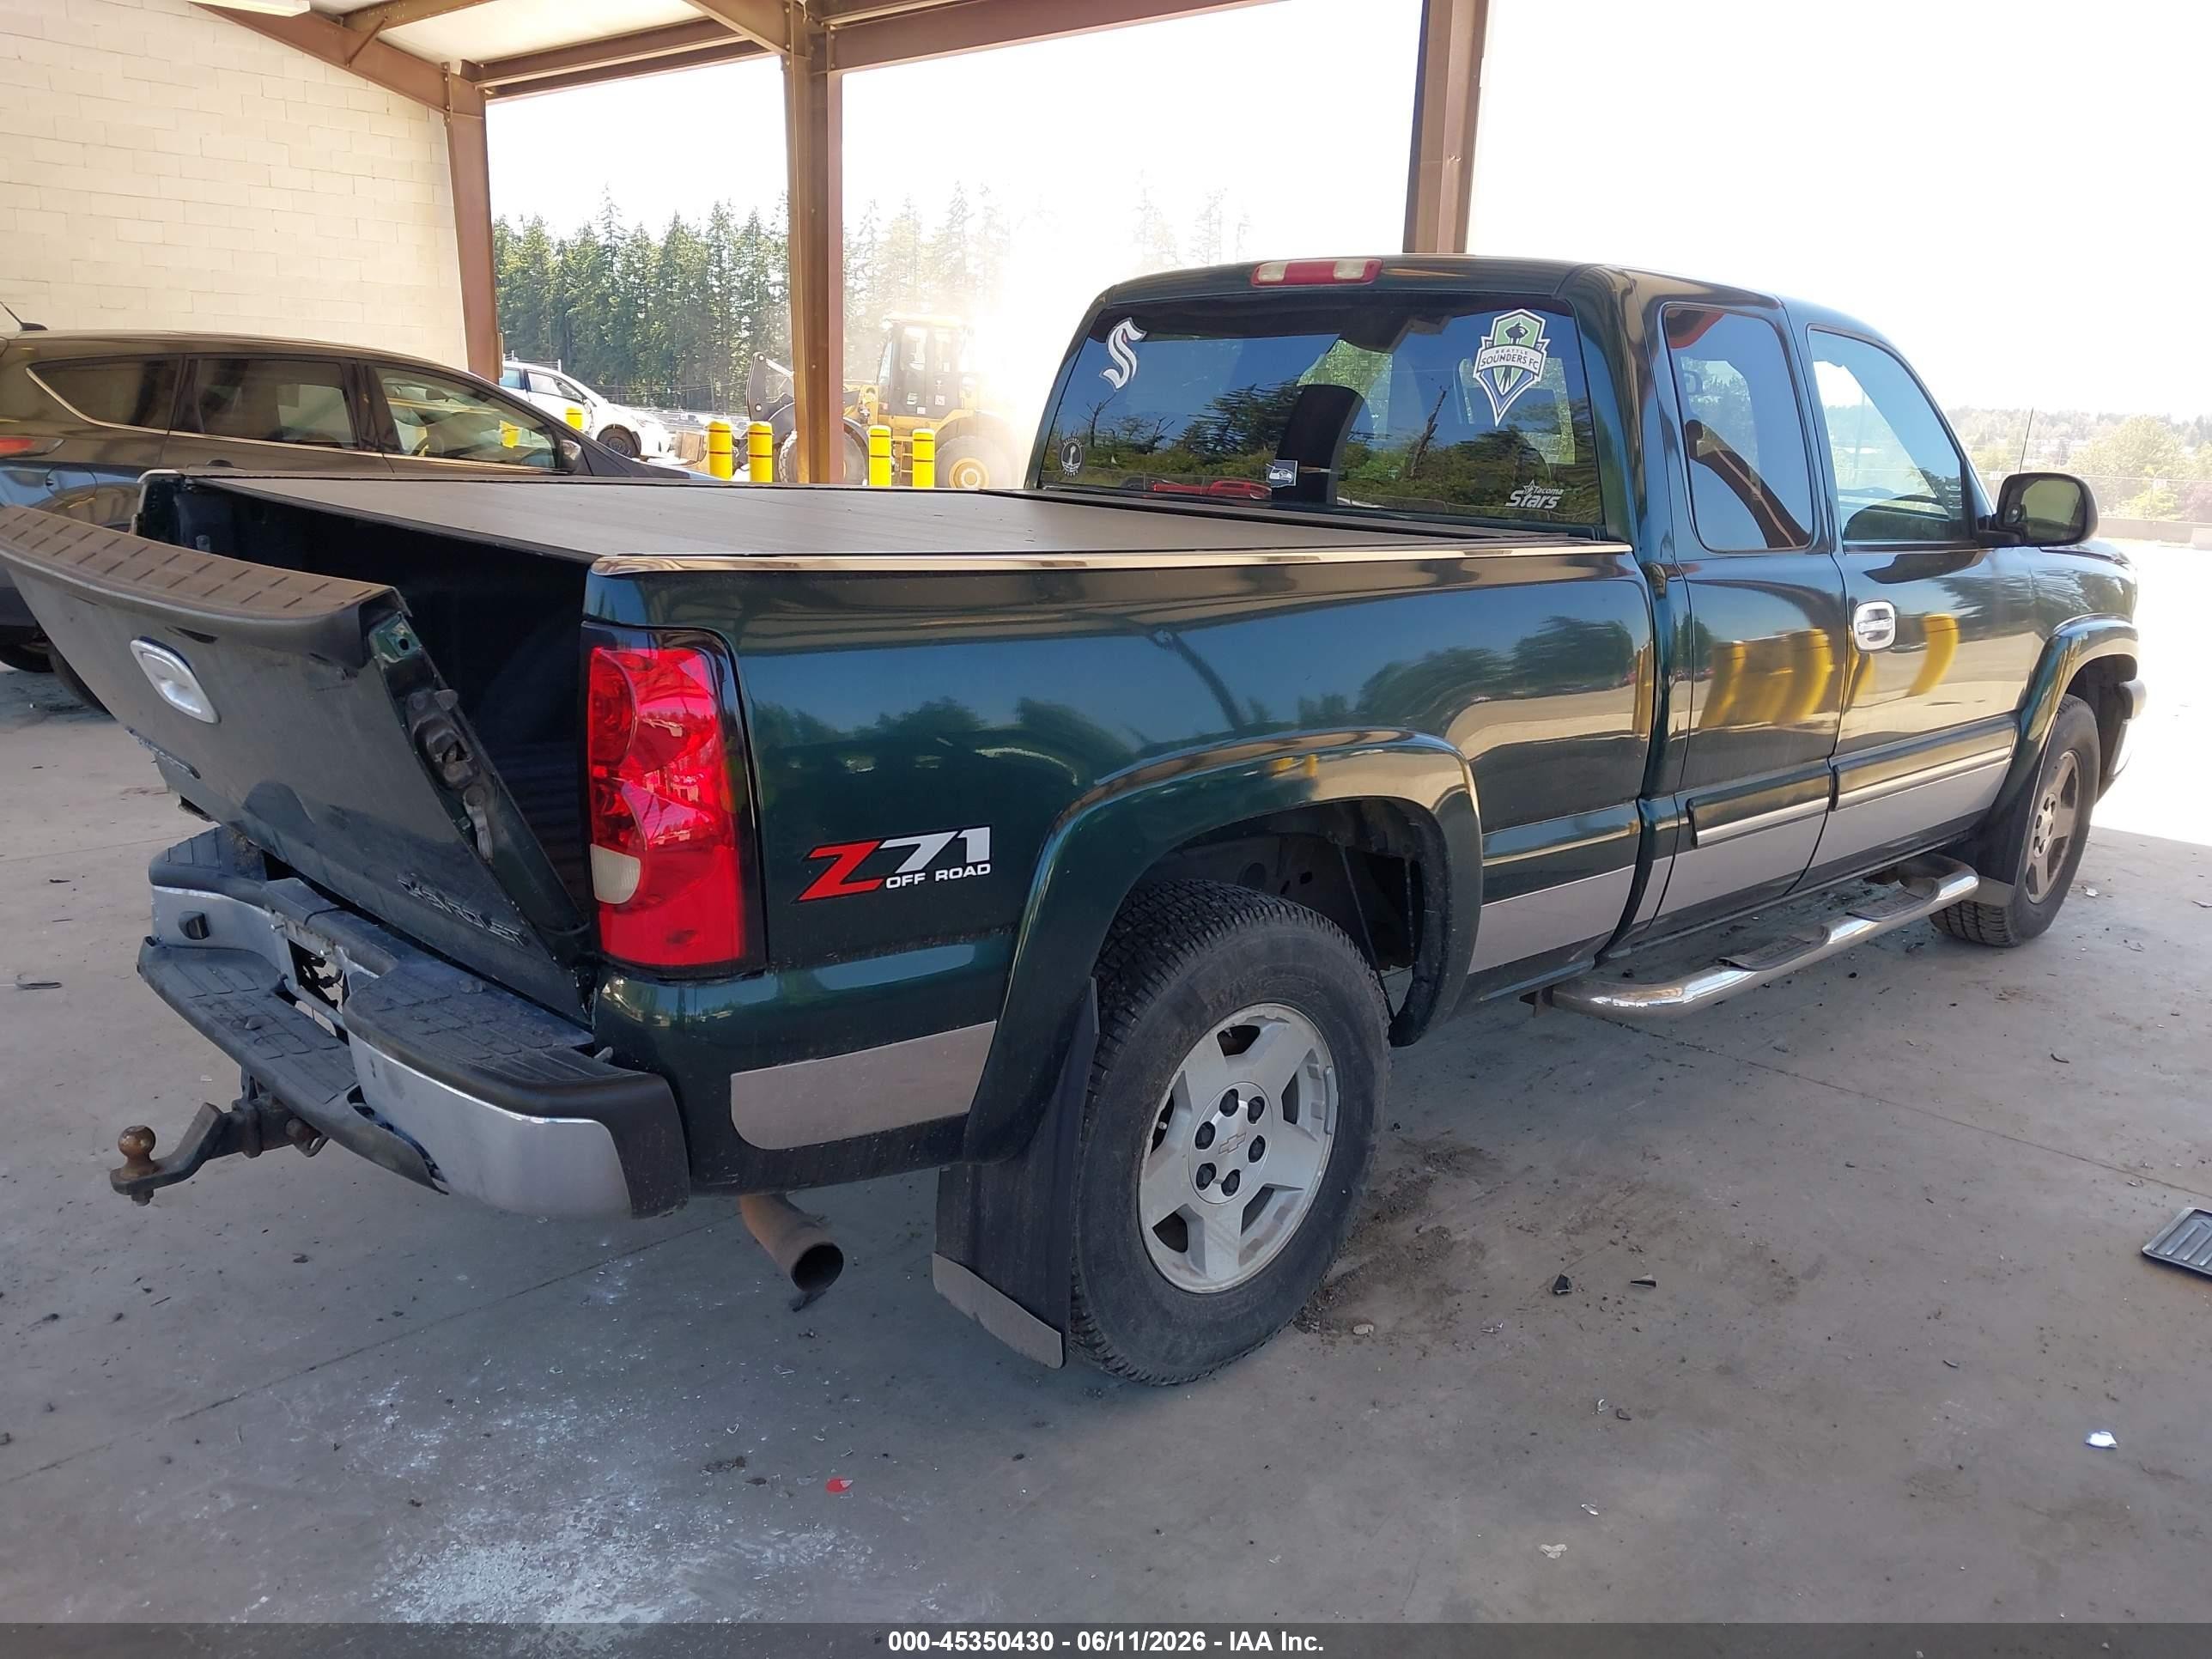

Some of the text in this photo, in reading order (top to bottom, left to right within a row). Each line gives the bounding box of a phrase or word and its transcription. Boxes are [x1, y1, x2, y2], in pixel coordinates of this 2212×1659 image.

[1480, 354, 1540, 370] SOUNDERS FC
[1504, 489, 1562, 509] Stars
[1534, 486, 1565, 495] Tacoma
[798, 825, 992, 902] Z71
[885, 863, 992, 890] OFF ROAD
